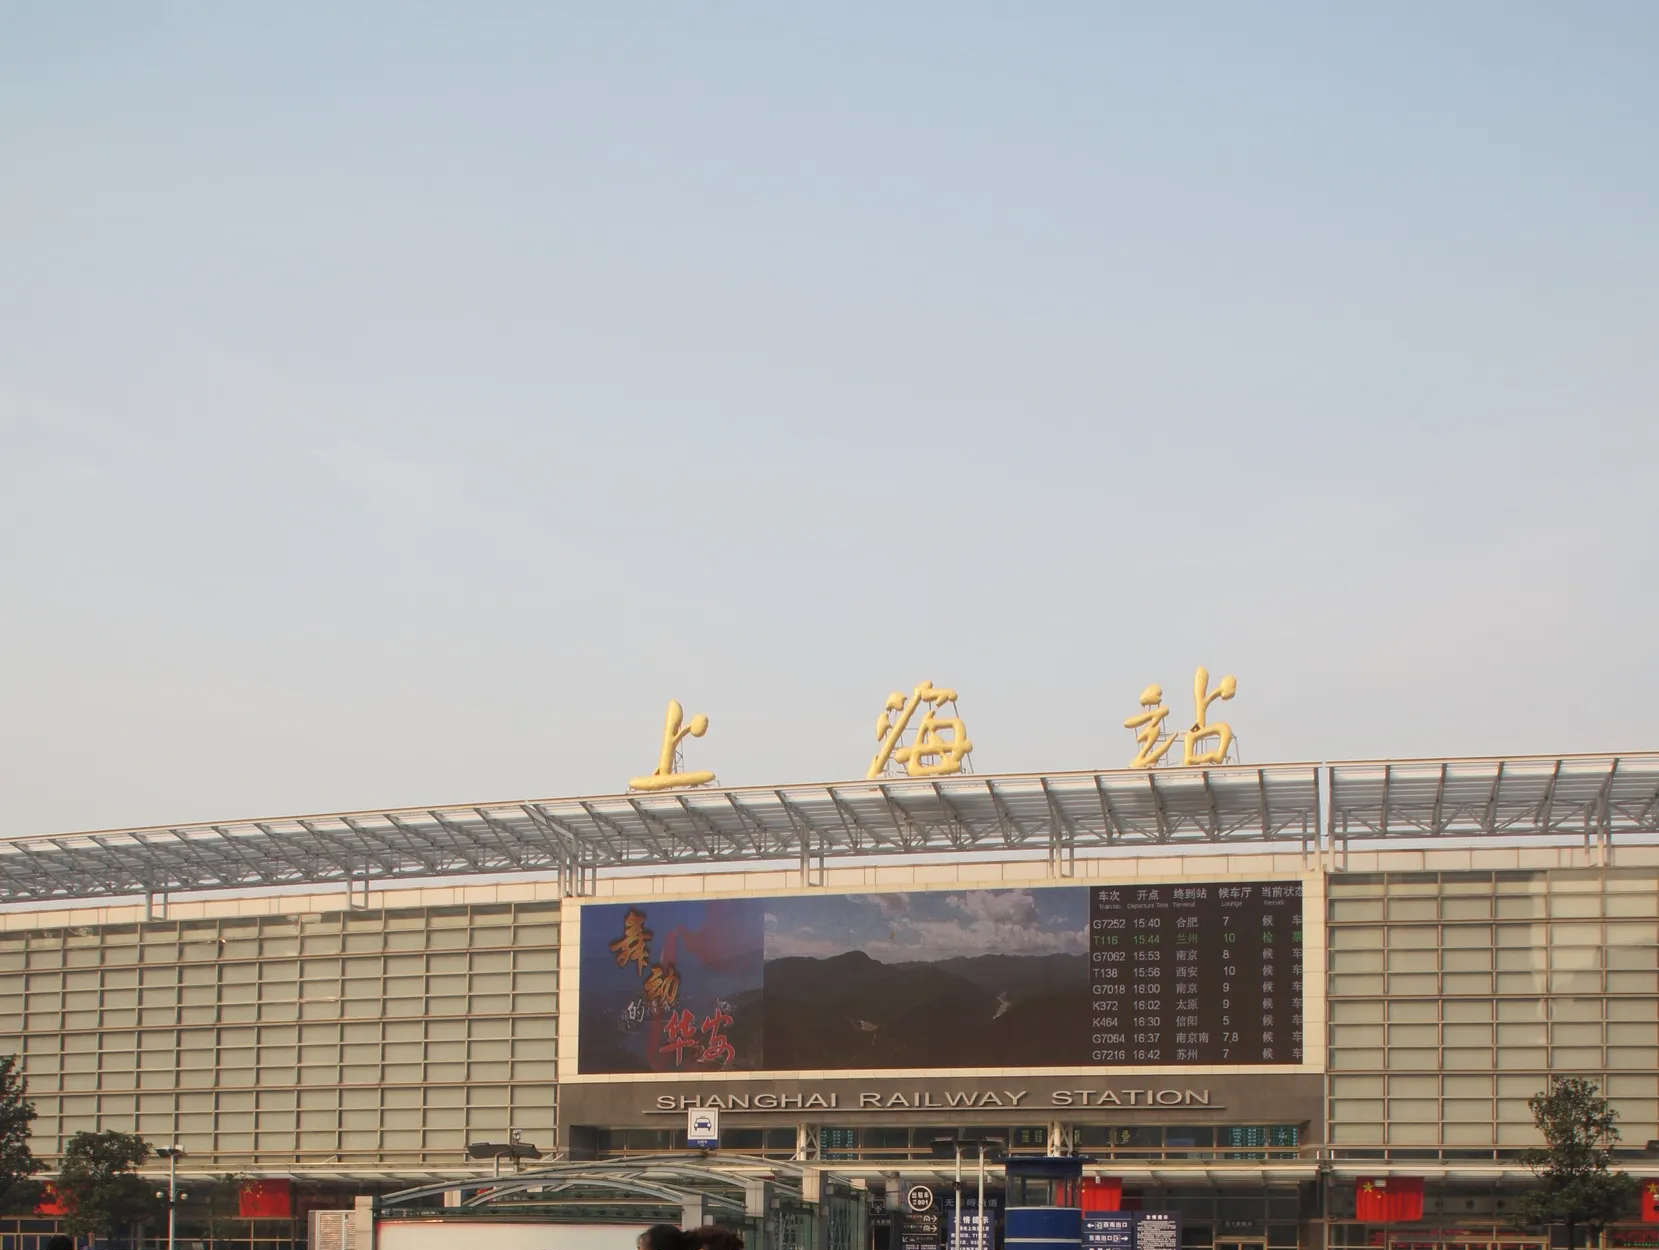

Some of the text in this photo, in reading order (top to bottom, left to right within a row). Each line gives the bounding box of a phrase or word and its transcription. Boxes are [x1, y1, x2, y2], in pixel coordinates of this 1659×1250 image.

[1099, 890, 1120, 902] 车次
[1137, 889, 1159, 900] 开点
[1173, 888, 1207, 900] 终到站
[1218, 887, 1252, 899] 候车厅
[1093, 919, 1125, 929] G7252
[1133, 919, 1160, 928] 15:40
[1223, 917, 1229, 926] 7
[1093, 936, 1118, 946] T116
[1224, 933, 1235, 943] 10
[1093, 952, 1125, 962] G7062
[1133, 951, 1160, 961] 15:53
[1222, 950, 1229, 959] 8
[1093, 969, 1117, 978] T138
[1133, 968, 1160, 977] 15:56
[1224, 966, 1235, 975] 10
[1093, 985, 1125, 994] G7018
[1133, 984, 1160, 994] 16:00
[1222, 982, 1229, 992] 9
[1093, 1001, 1118, 1011] K372
[1222, 999, 1229, 1008] 9
[1093, 1018, 1118, 1027] K464
[1133, 1017, 1160, 1026] 16:30
[1222, 1016, 1229, 1025] 5
[1093, 1034, 1125, 1044] G7064
[1133, 1033, 1160, 1043] 16:37
[1093, 1051, 1125, 1060] G7216
[1133, 1050, 1160, 1060] 16:42
[1223, 1049, 1229, 1058] 7
[656, 1088, 1212, 1110] SHANGHAI RAILWAY STATION
